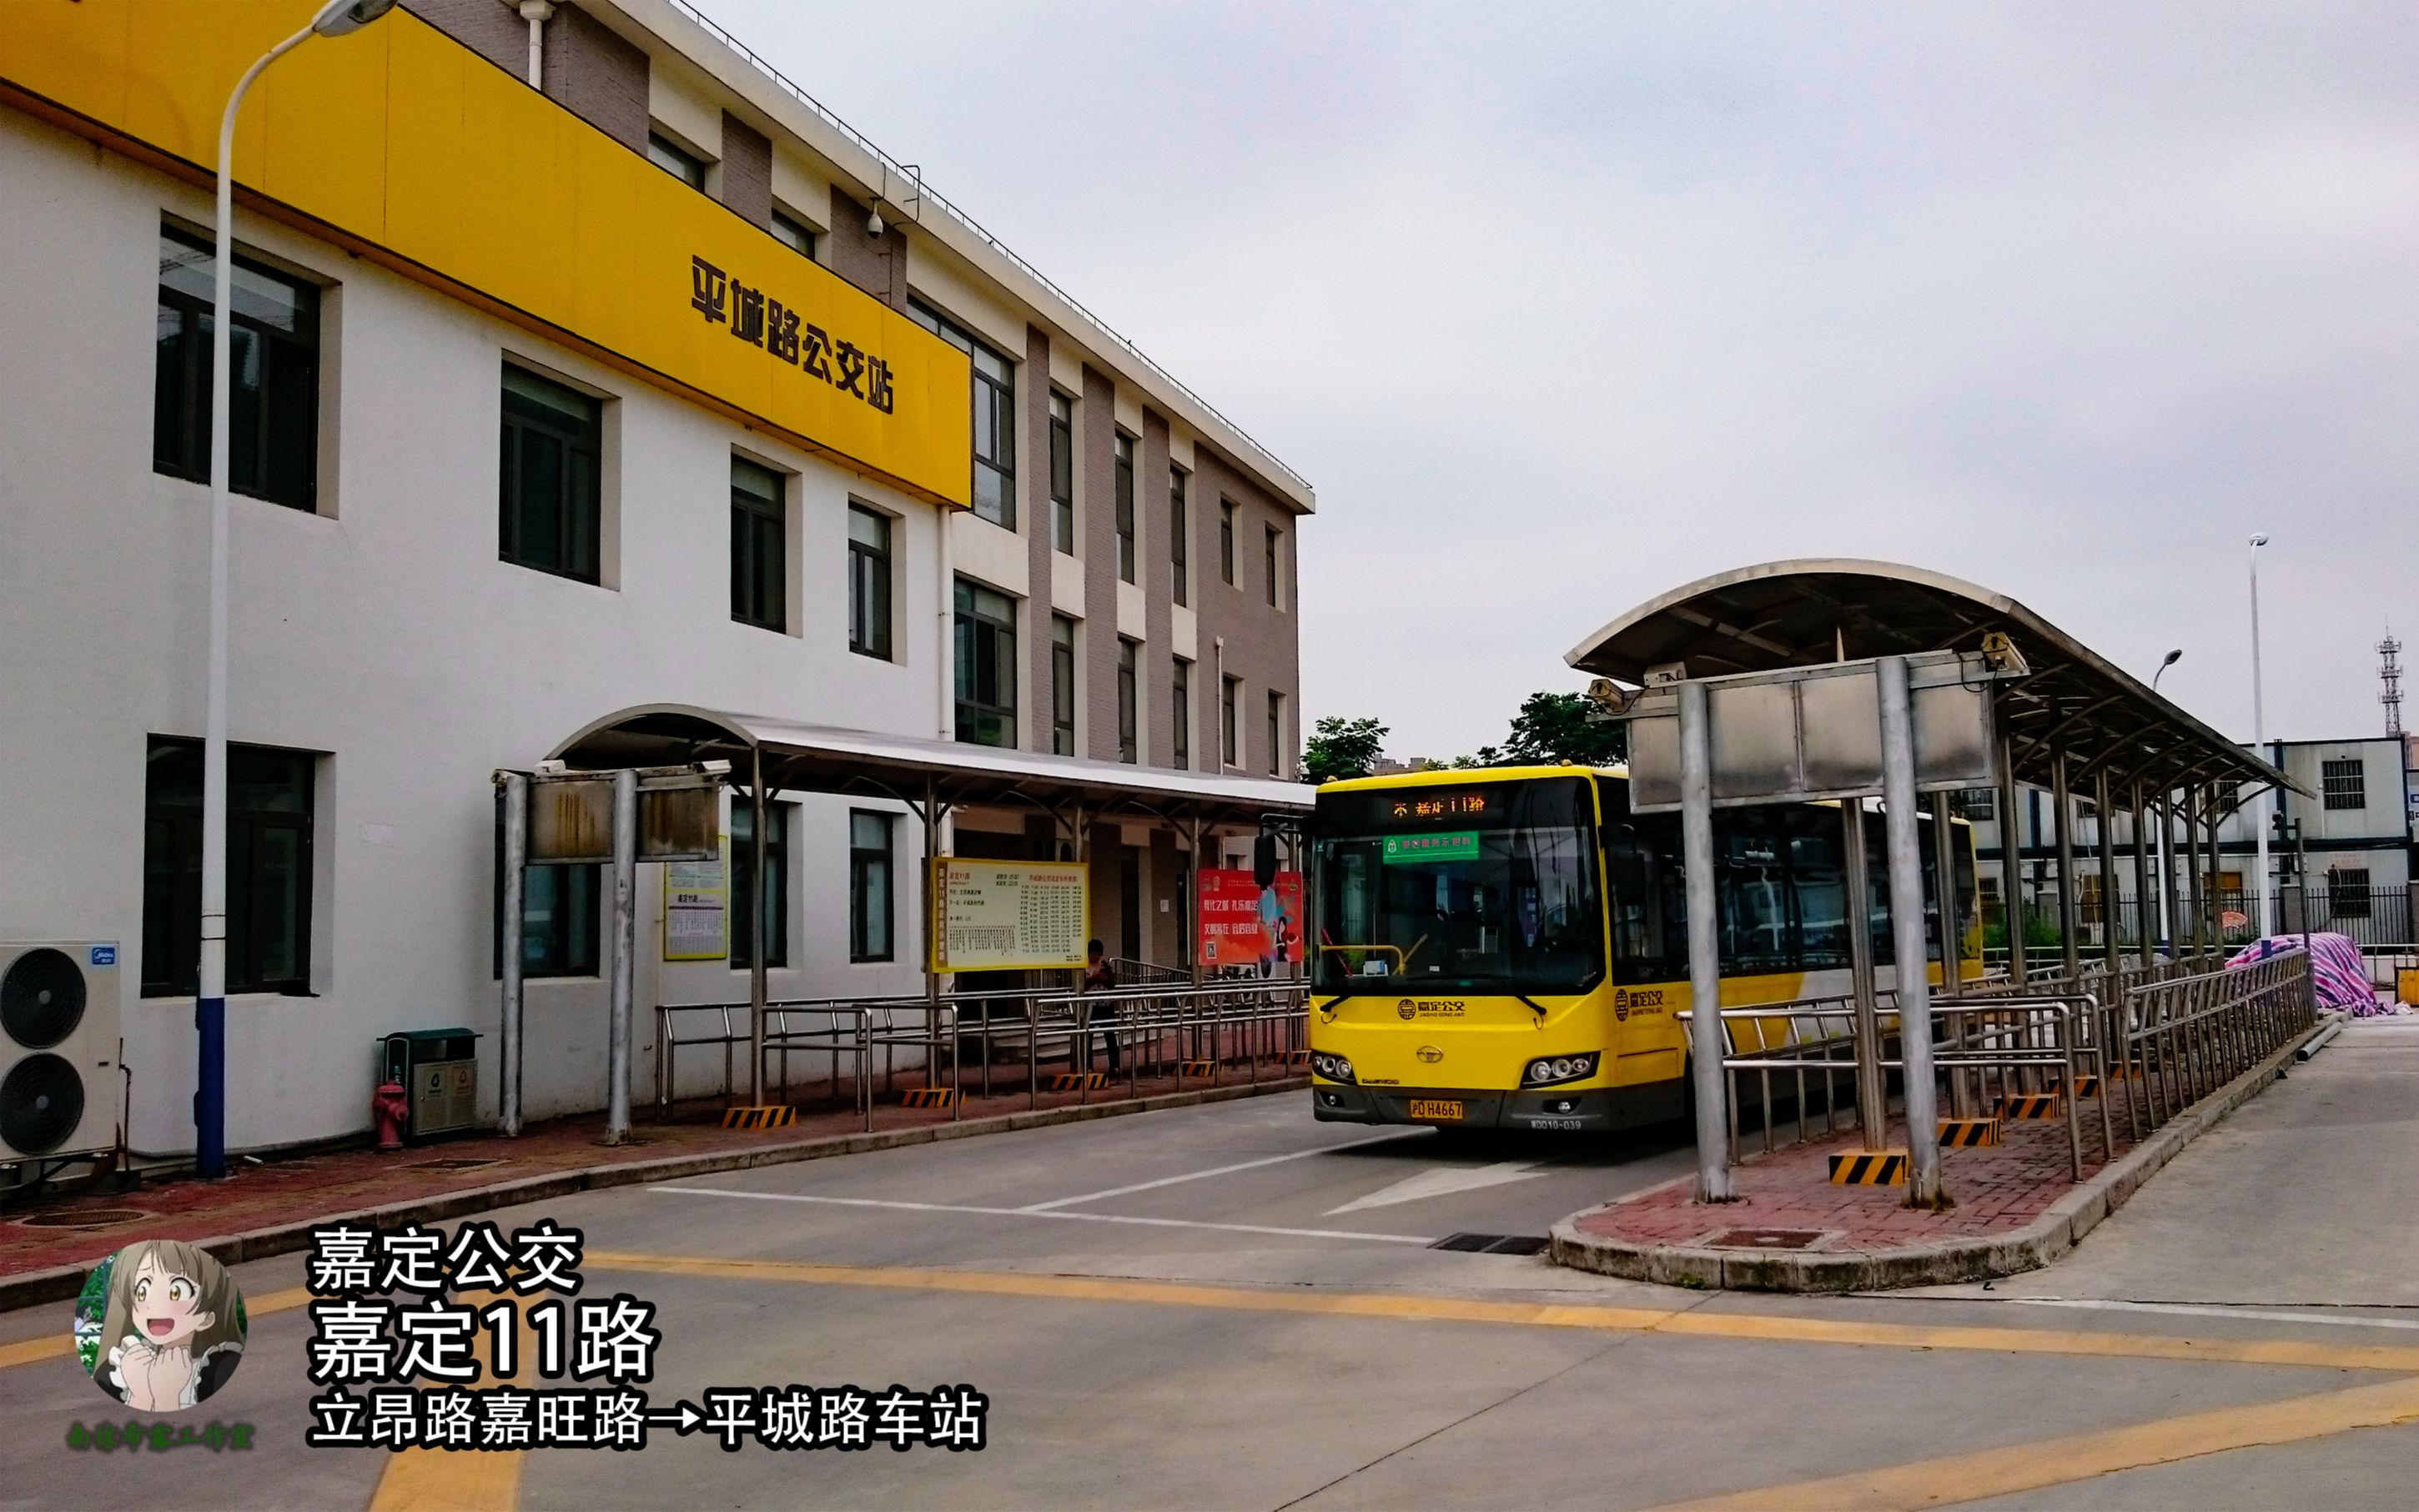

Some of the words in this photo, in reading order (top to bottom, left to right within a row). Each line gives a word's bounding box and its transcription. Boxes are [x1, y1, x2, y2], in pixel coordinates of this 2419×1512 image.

[692, 254, 893, 414] 平城路公交站
[1418, 1001, 1466, 1012] 嘉定公交
[1630, 990, 1663, 1007] 嘉定公交
